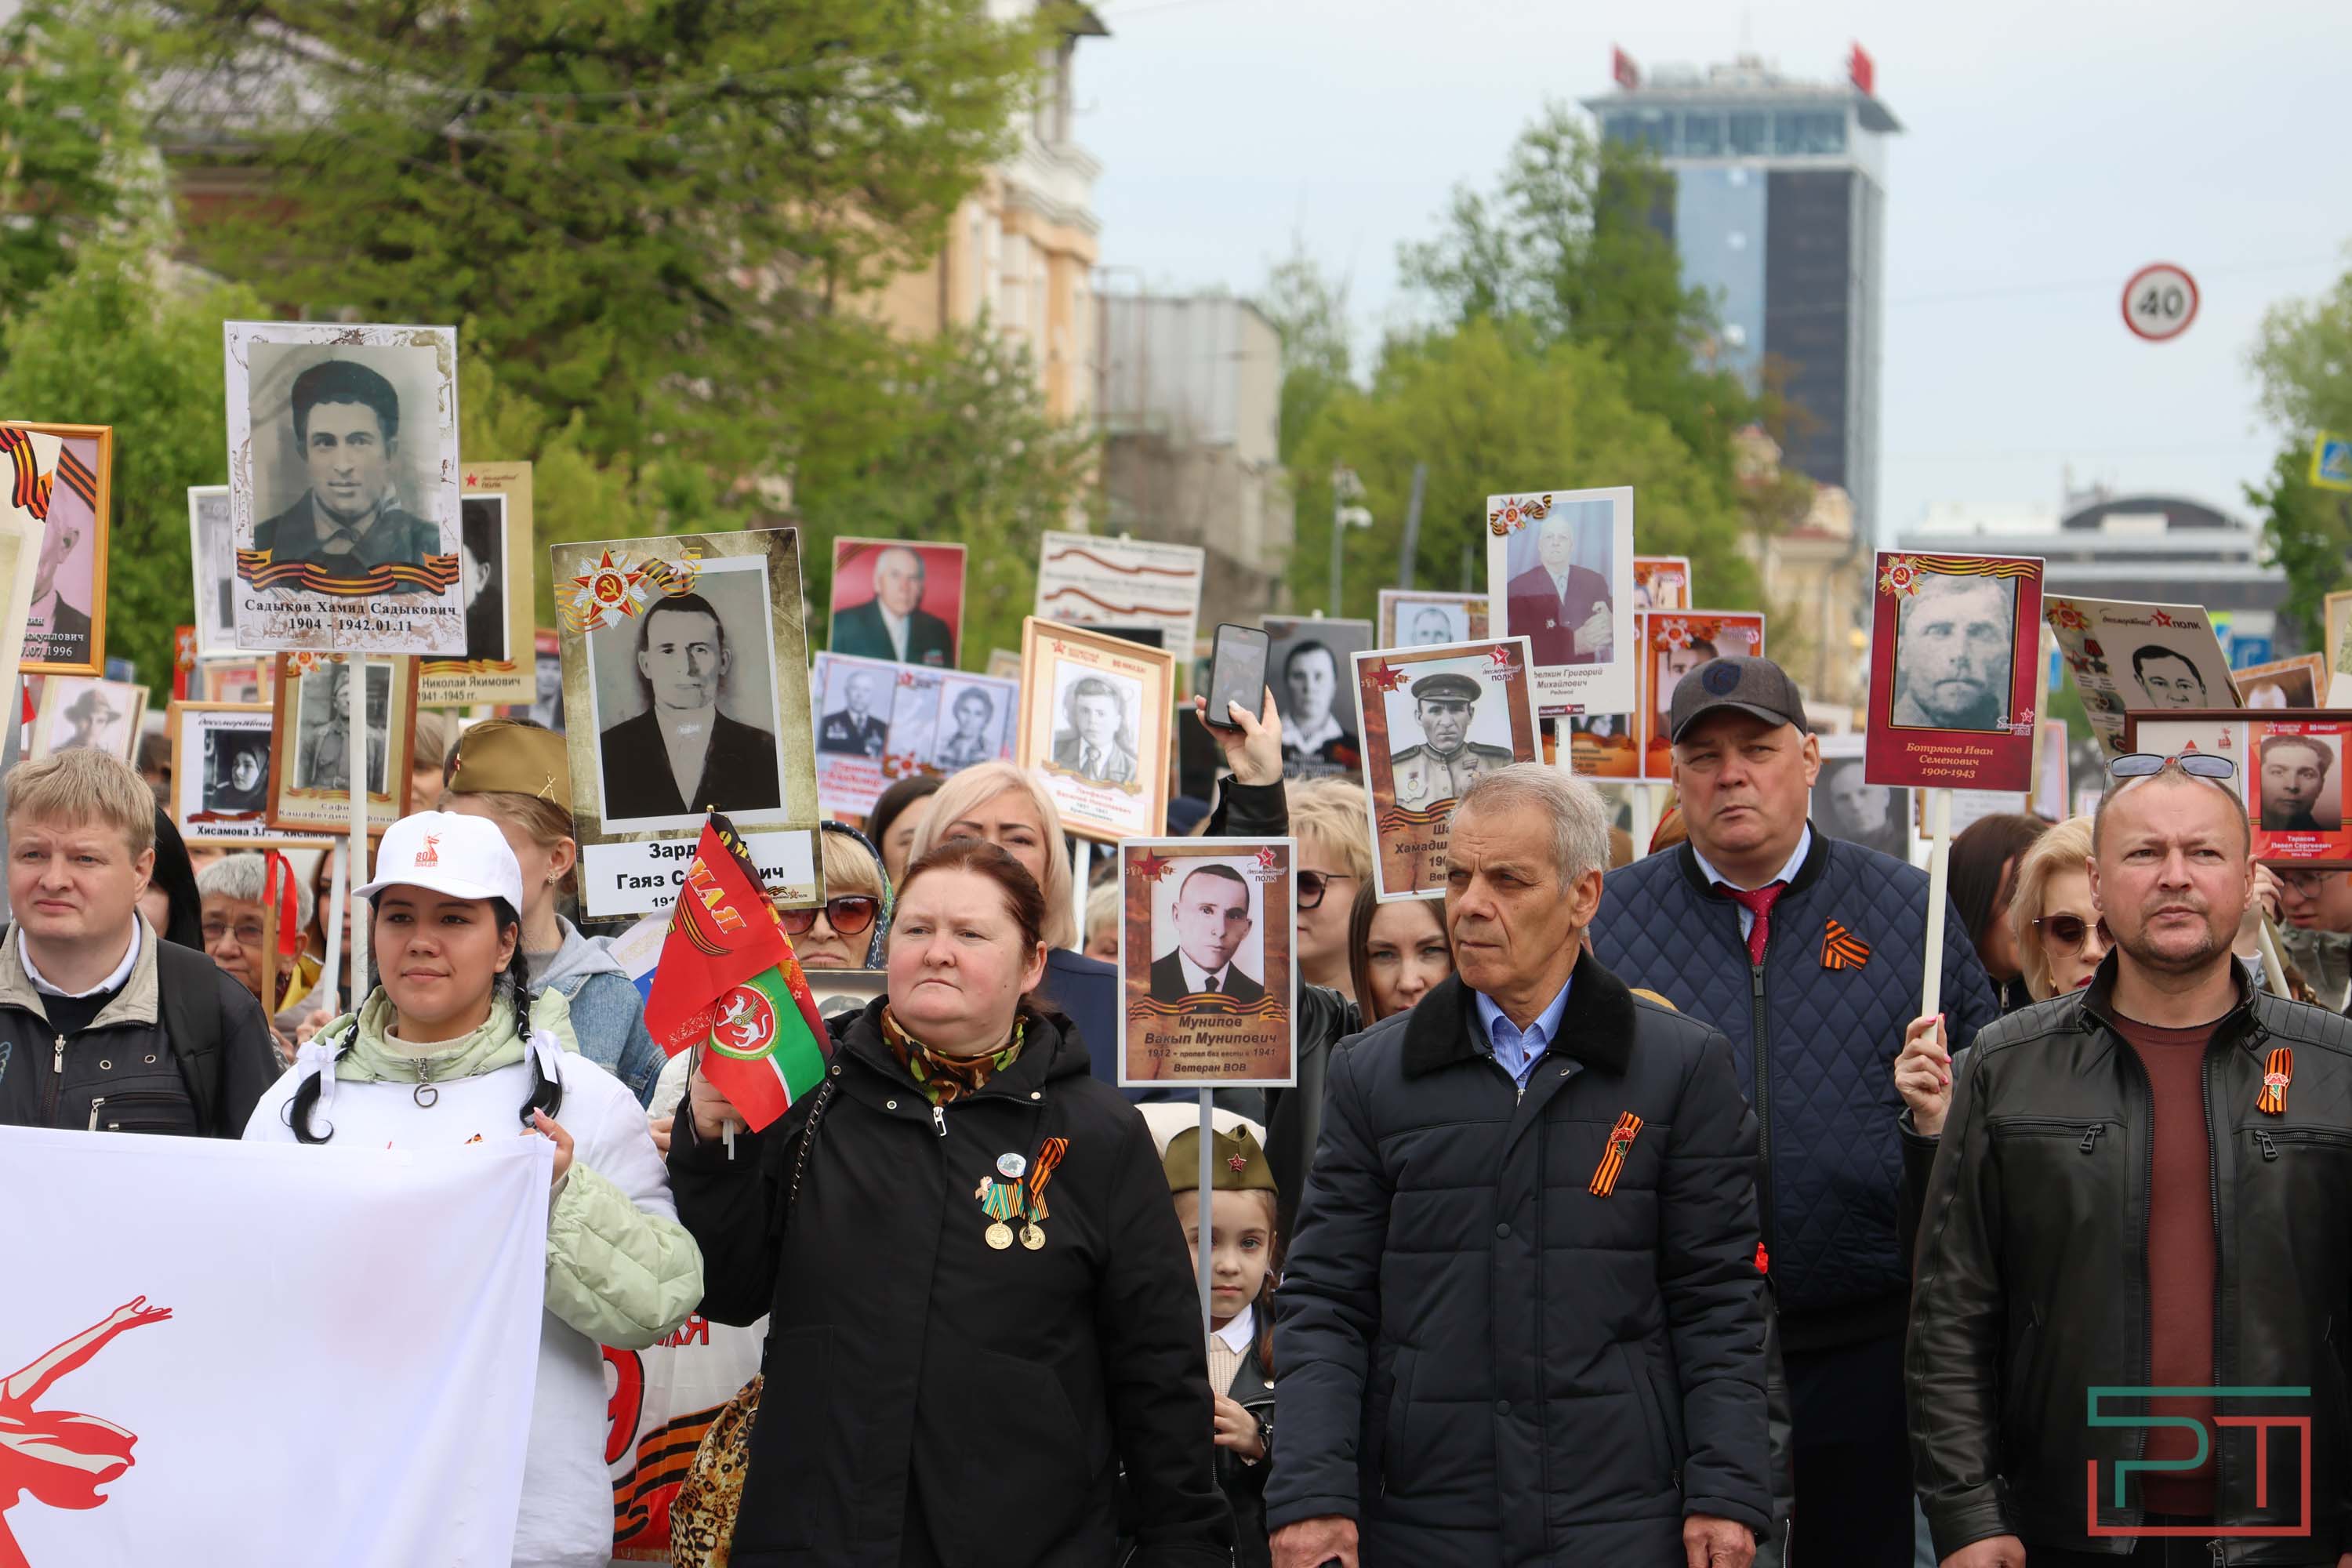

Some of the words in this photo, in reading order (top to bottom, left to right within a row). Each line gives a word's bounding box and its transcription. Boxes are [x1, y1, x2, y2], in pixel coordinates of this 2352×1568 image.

[2139, 285, 2184, 320] 40
[245, 599, 311, 612] Садыков
[317, 601, 365, 614] Хамид
[371, 601, 456, 615] Садыкович
[289, 618, 321, 630] 1904
[339, 619, 412, 631] 1942.01.11
[1564, 668, 1602, 677] Григорий
[422, 676, 466, 688] Николай
[470, 675, 521, 688] Якимович
[1537, 680, 1588, 689] Михайлович
[1907, 742, 1962, 755] Ботряков
[1964, 746, 1994, 755] Иван
[1918, 755, 1980, 766] Семенович
[1921, 767, 1976, 779] 1900-1943
[197, 826, 249, 837] Хисамова
[1395, 840, 1447, 854] Хамадш
[416, 851, 428, 862] 80
[617, 873, 665, 890] Гаяз
[687, 857, 746, 935] МАЯ
[1178, 1016, 1243, 1029] Мунипов
[1145, 1033, 1192, 1044] Вакып
[1196, 1032, 1277, 1046] Мунипович
[1147, 1049, 1171, 1058] 1912
[1174, 1063, 1221, 1073] Ветеран
[1224, 1063, 1247, 1072] ВОВ
